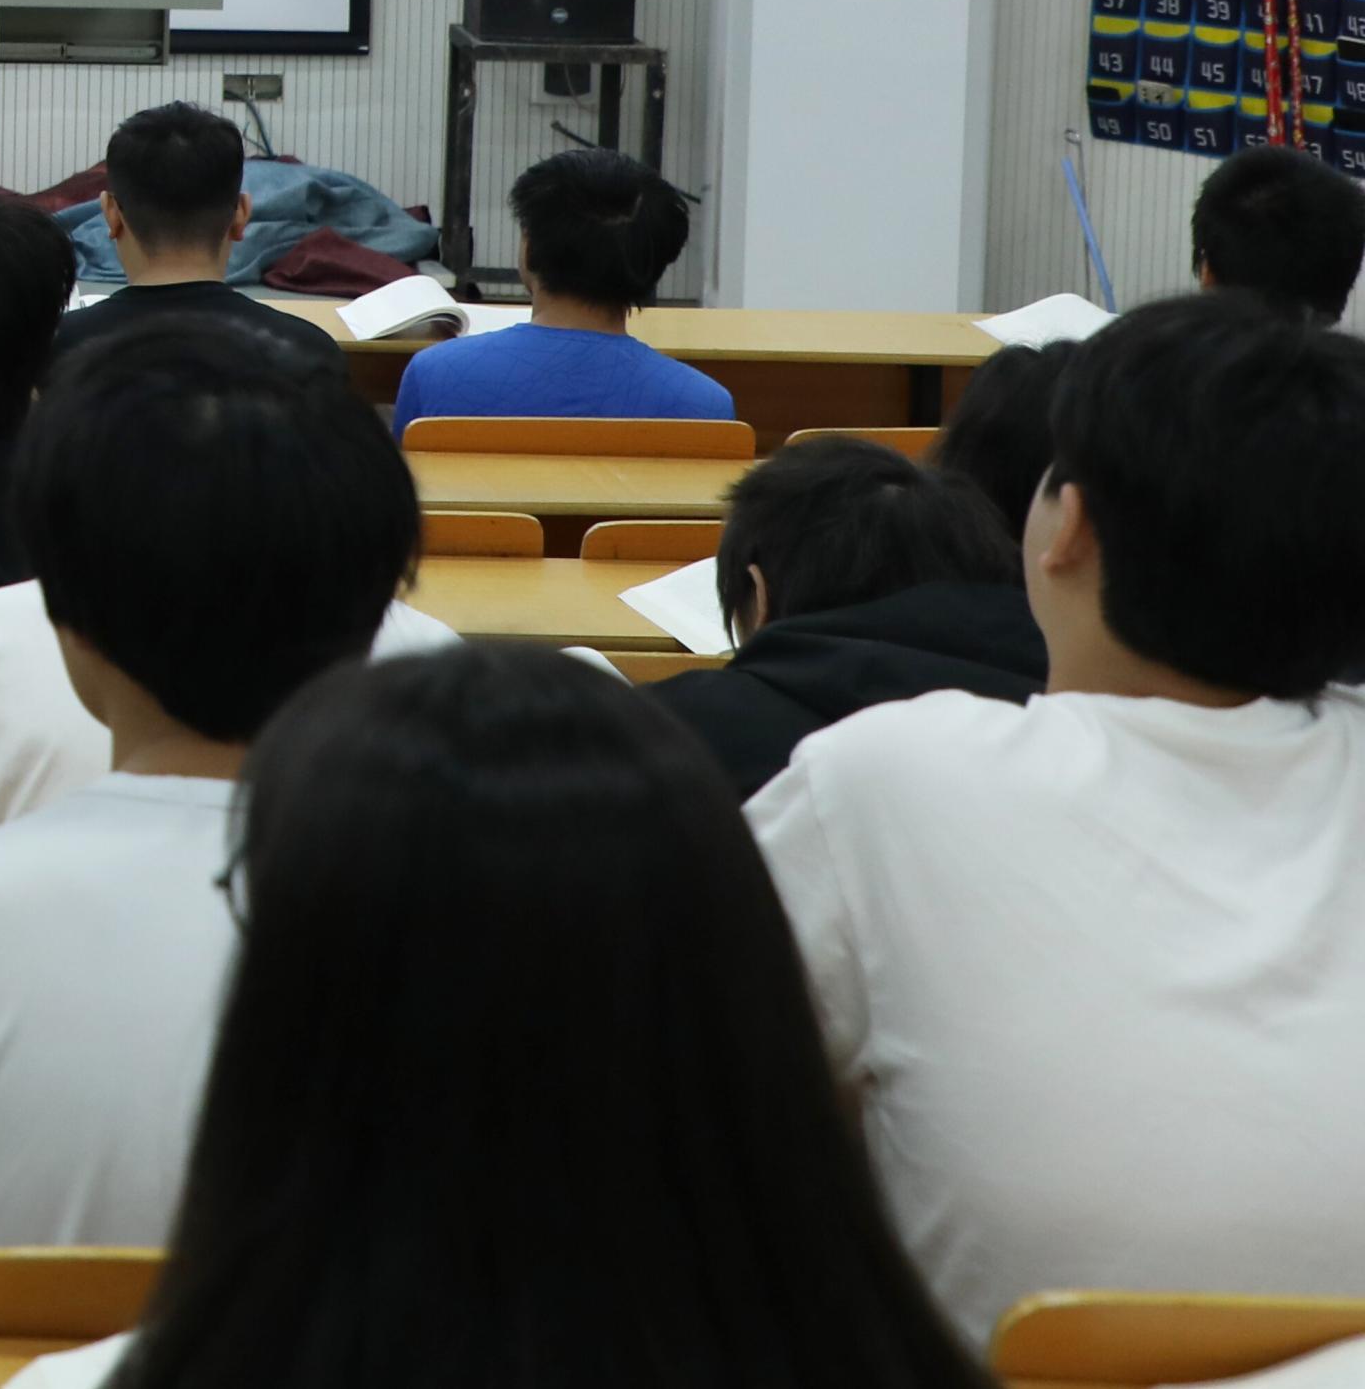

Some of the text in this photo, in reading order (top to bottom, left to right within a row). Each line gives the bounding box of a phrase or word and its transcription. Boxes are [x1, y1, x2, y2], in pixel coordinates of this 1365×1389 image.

[1099, 52, 1123, 73] 43
[1150, 55, 1174, 77] 44
[1201, 62, 1225, 83] 45
[1097, 117, 1121, 135] 49
[1147, 121, 1172, 141] 50
[1194, 127, 1217, 147] 51
